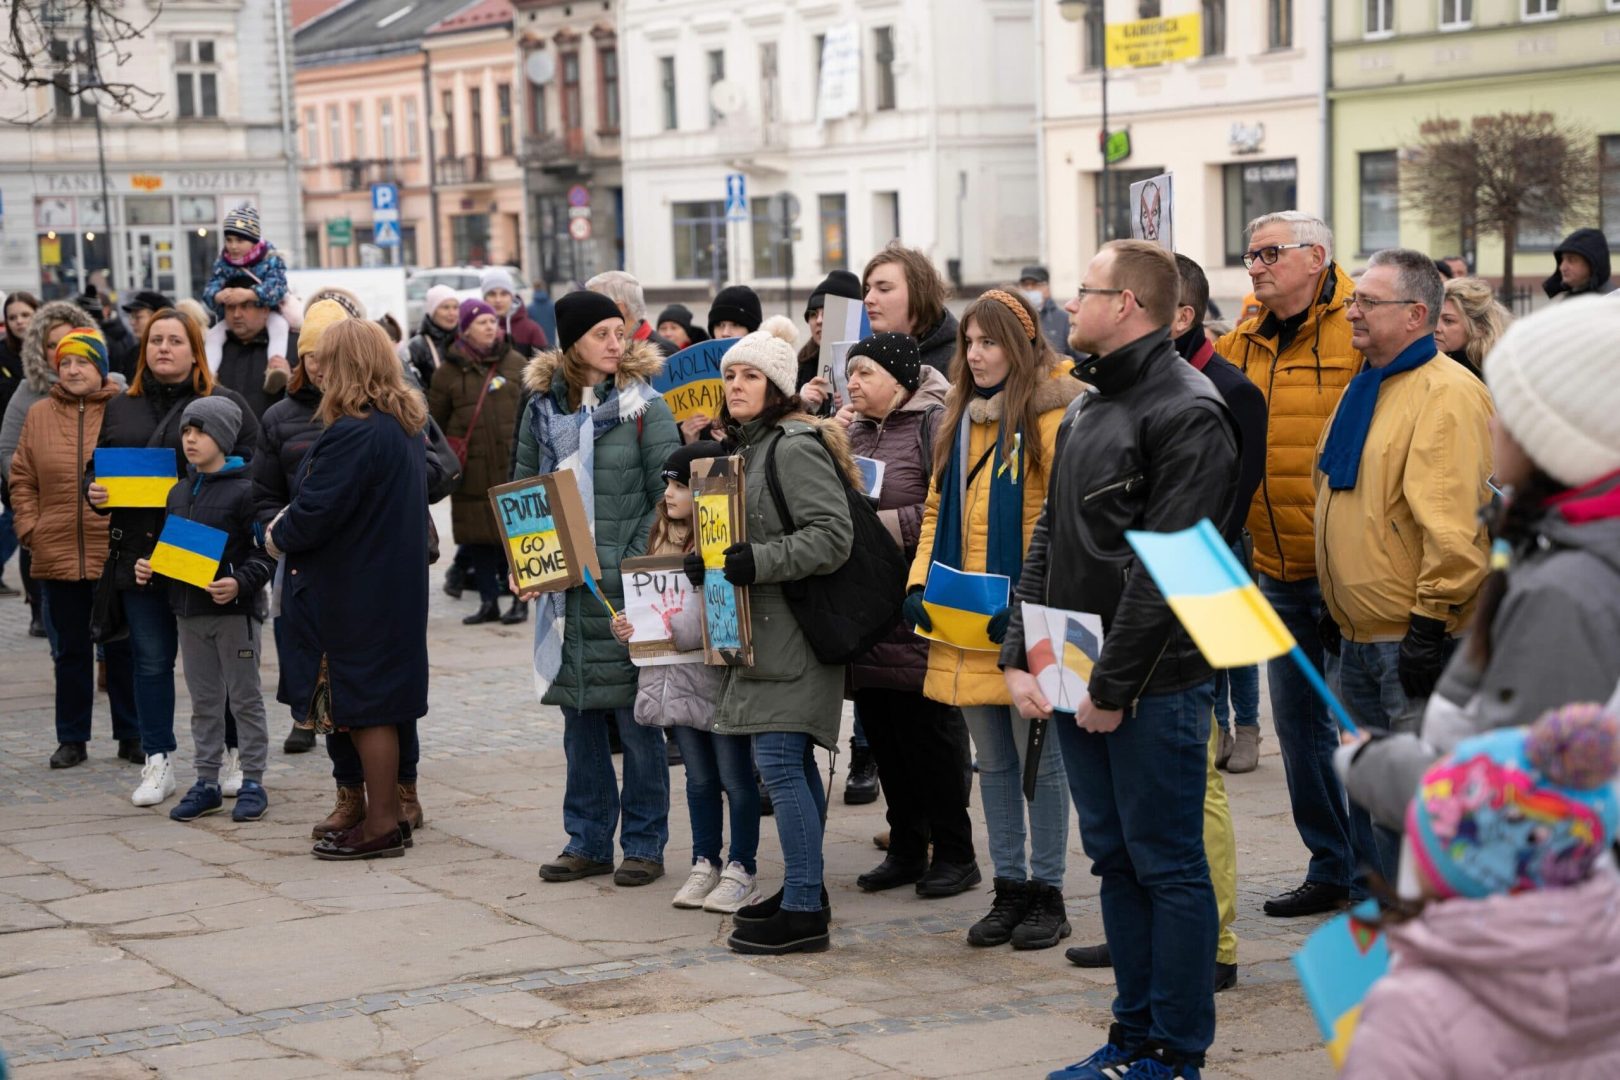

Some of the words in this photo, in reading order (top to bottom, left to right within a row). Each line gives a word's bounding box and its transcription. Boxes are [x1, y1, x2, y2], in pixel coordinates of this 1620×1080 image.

[47, 174, 115, 190] TANIA
[376, 186, 392, 209] P
[500, 492, 551, 525] PUTIN
[699, 505, 728, 546] Putin
[521, 536, 545, 554] GO
[514, 550, 567, 580] HOME
